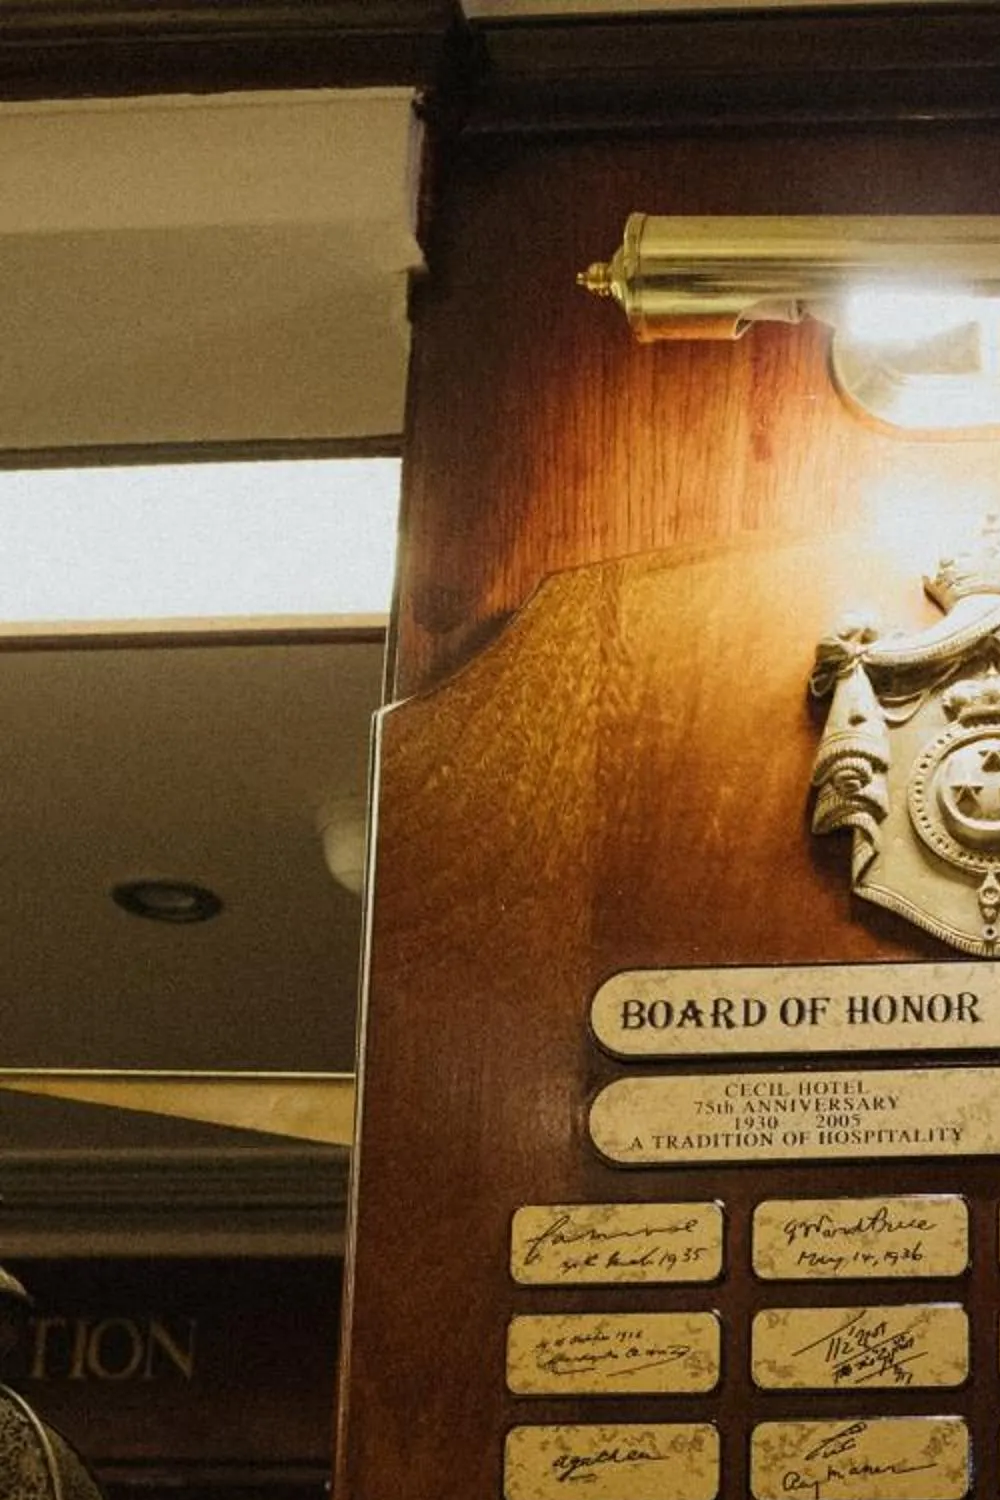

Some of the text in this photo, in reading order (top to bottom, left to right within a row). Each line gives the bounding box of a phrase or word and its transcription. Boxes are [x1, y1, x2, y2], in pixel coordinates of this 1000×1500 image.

[620, 992, 984, 1030] BOARD OF HONOR
[724, 1079, 871, 1098] CECIL HOTEL
[741, 1096, 900, 1114] ANNIVERSARY
[733, 1113, 862, 1131] 1930 2005
[651, 1132, 774, 1149] TRADITION
[782, 1131, 811, 1147] OF
[817, 1125, 964, 1146] HOSPITALITY
